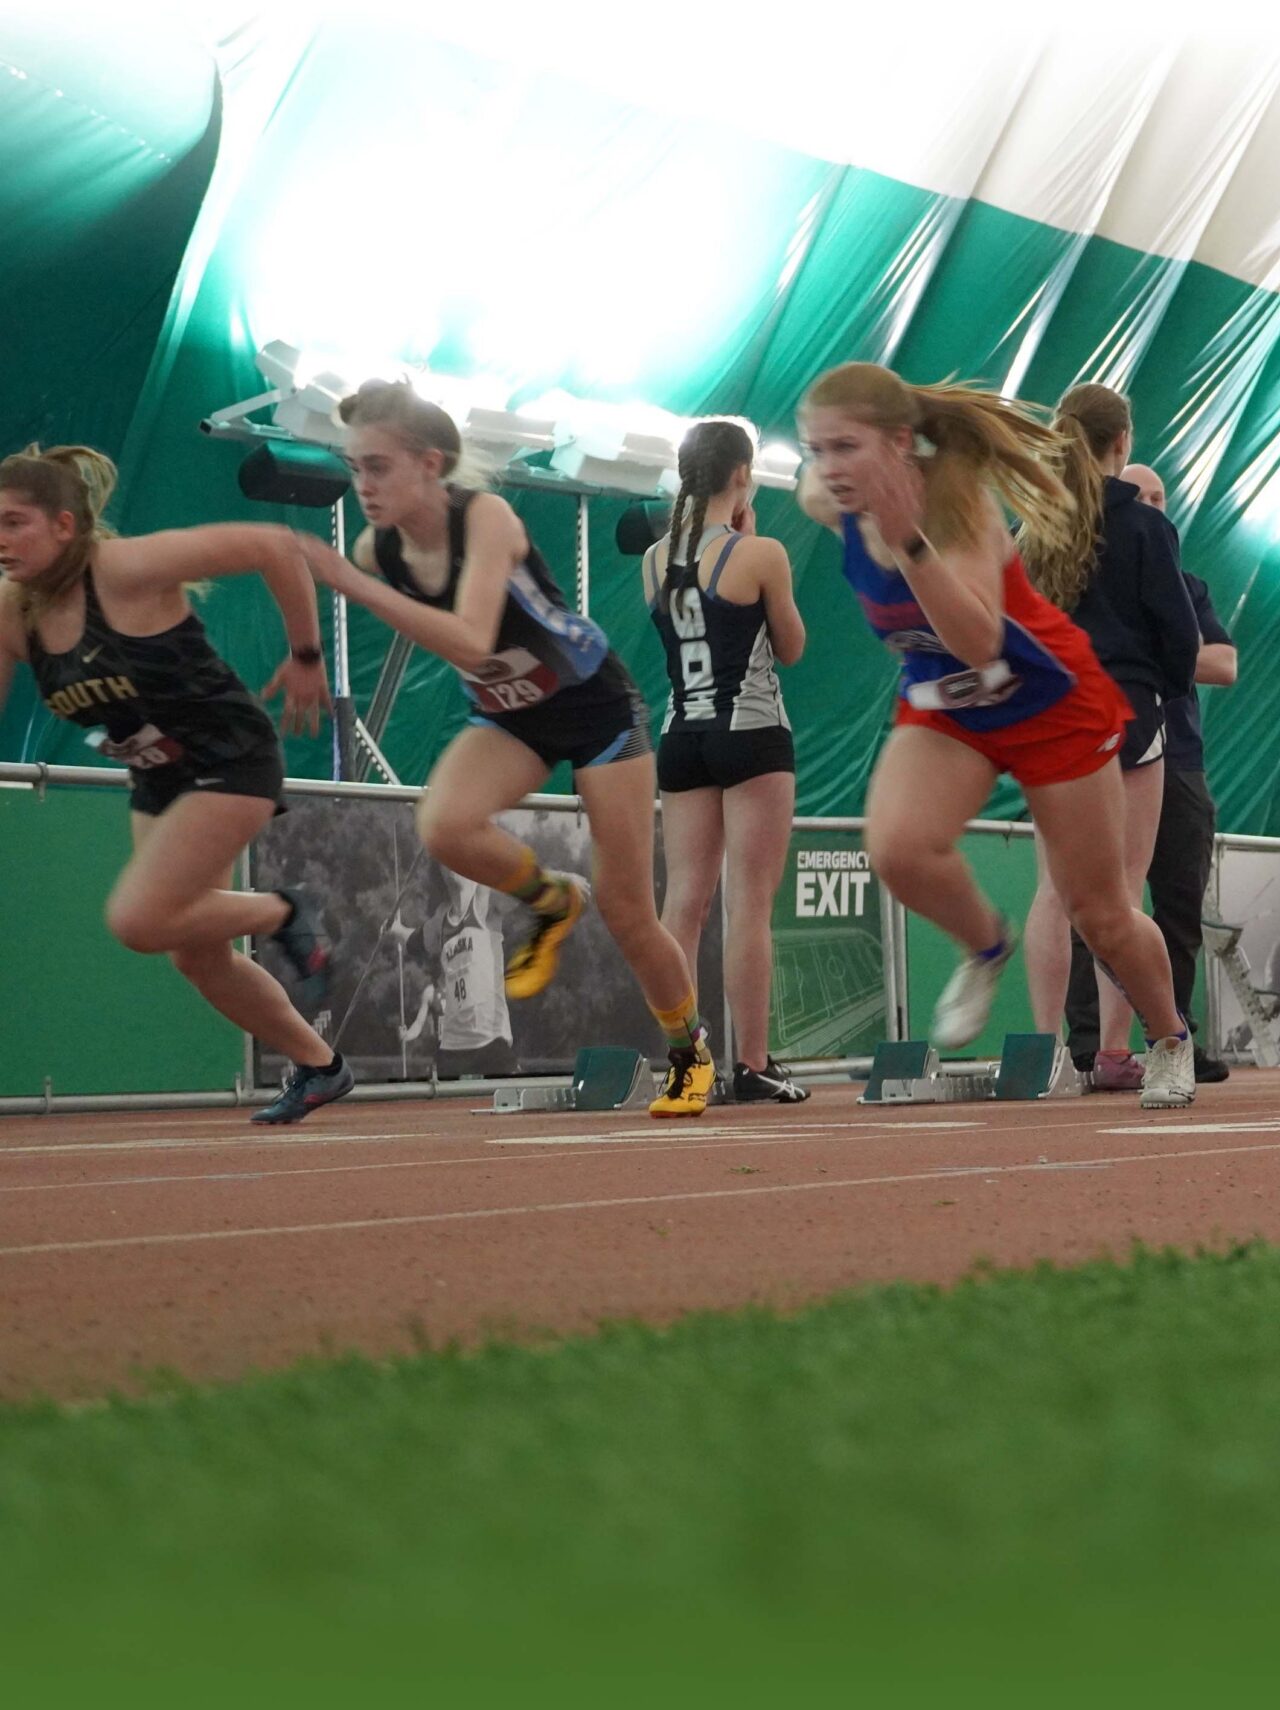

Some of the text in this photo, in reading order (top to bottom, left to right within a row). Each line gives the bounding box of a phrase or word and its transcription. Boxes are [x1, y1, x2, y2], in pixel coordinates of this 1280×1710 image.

[486, 678, 547, 710] 129
[797, 850, 871, 869] EMERGENCY
[796, 871, 871, 917] EXIT
[454, 977, 467, 1002] 48
